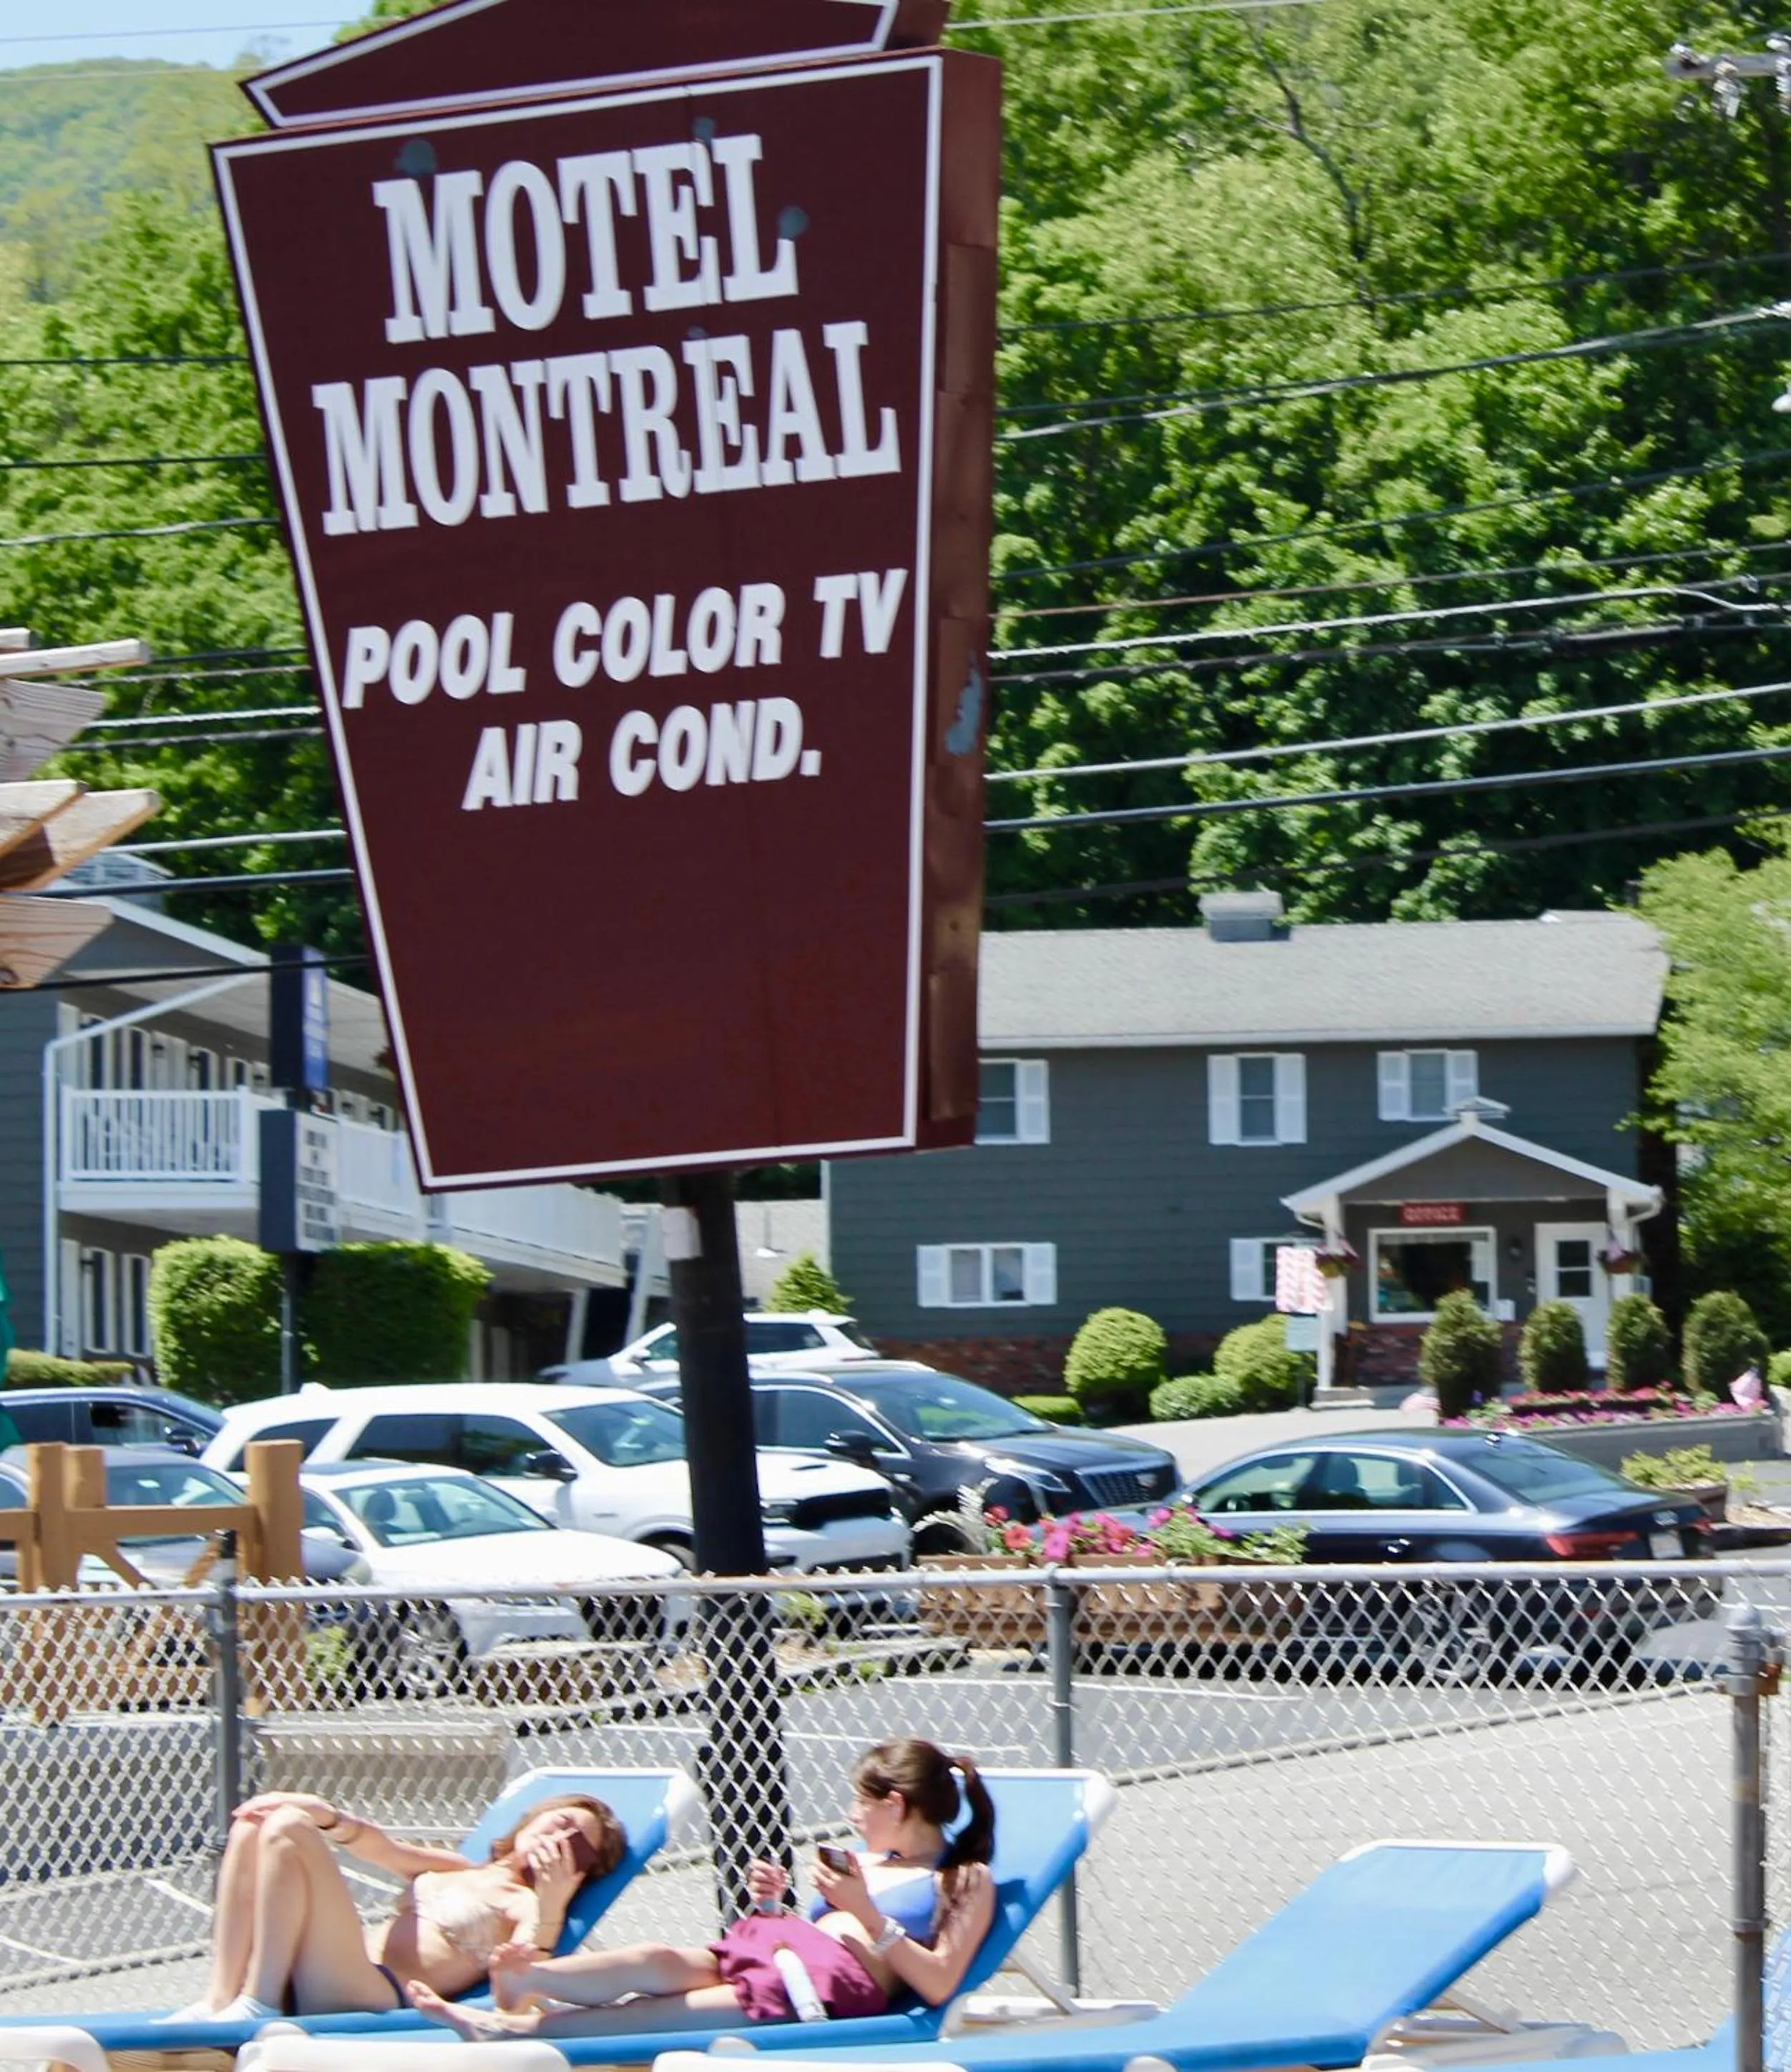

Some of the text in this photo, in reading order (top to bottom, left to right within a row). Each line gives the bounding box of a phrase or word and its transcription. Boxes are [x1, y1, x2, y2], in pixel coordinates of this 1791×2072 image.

[372, 133, 799, 344] MOTEL
[311, 320, 902, 536] MONTREAL
[342, 568, 908, 709] POOL COLOR TV
[461, 696, 822, 812] AIR COND.
